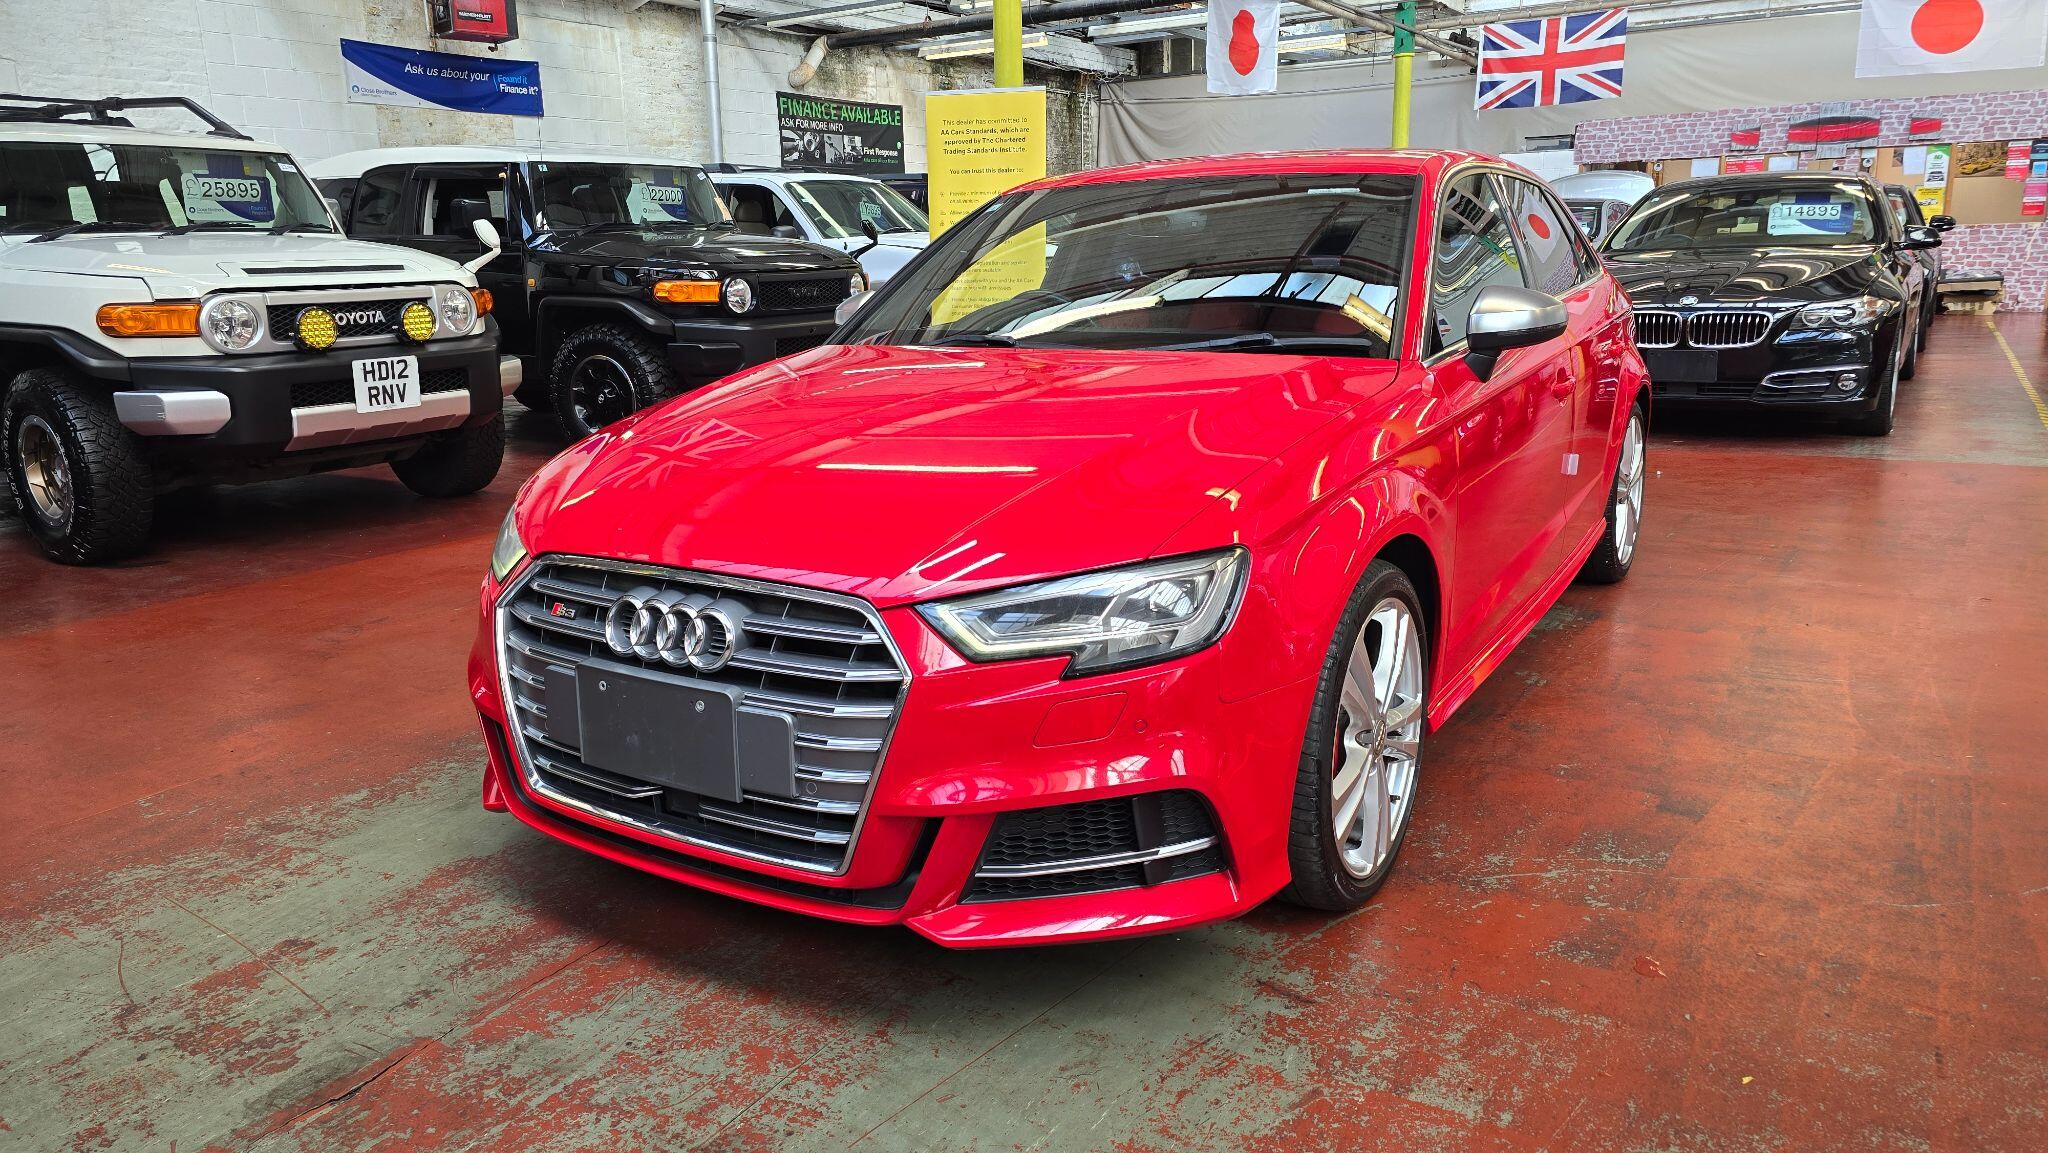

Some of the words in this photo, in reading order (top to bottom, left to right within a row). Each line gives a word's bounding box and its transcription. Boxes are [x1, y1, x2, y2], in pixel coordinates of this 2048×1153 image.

[405, 63, 424, 75] Ask
[426, 66, 439, 76] us
[441, 68, 468, 79] about
[470, 73, 490, 82] your
[497, 75, 522, 84] Found
[522, 76, 528, 84] it
[500, 83, 528, 94] Finance
[528, 85, 539, 95] it?
[780, 97, 838, 120] FINANCE
[841, 105, 902, 126] AVAILABLE
[781, 118, 795, 128] ASK
[796, 119, 810, 129] FOR
[810, 121, 828, 131] MORE
[828, 122, 844, 132] INFO
[944, 138, 973, 146] approved
[863, 147, 874, 156] First
[875, 147, 899, 157] Response
[943, 148, 966, 156] Trading
[362, 359, 409, 382] HD12
[367, 383, 407, 406] RNV
